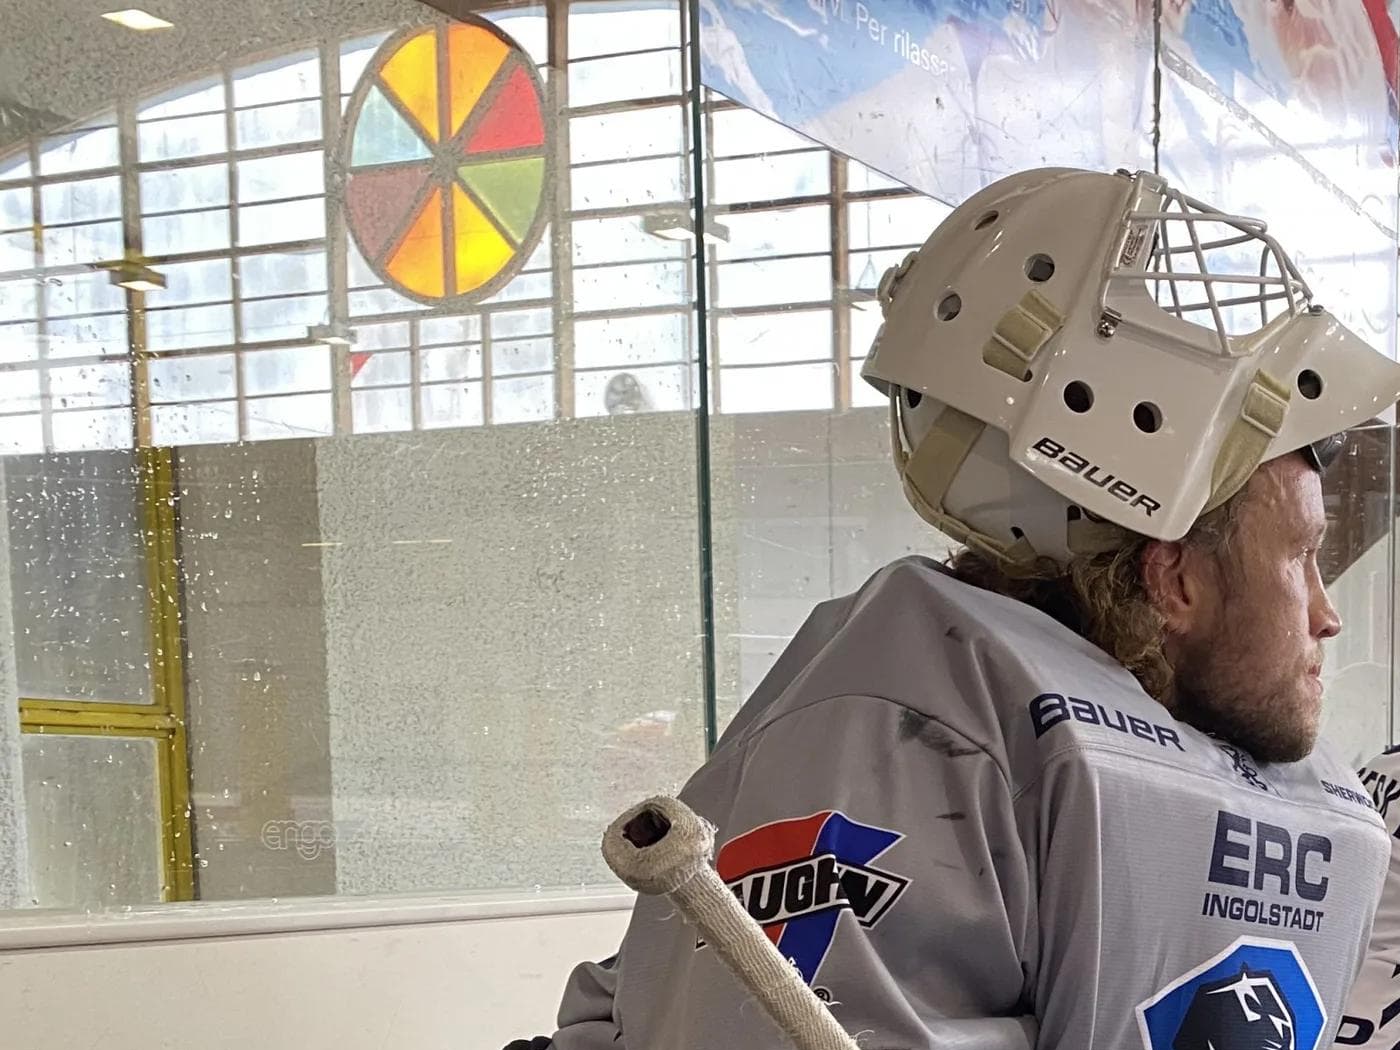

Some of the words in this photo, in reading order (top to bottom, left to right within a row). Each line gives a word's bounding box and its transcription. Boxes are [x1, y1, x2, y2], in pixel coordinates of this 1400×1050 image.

[856, 2, 888, 46] Per
[1029, 692, 1186, 752] BAUER
[1208, 810, 1333, 902] ERC
[1201, 893, 1325, 933] INGOLSTADT
